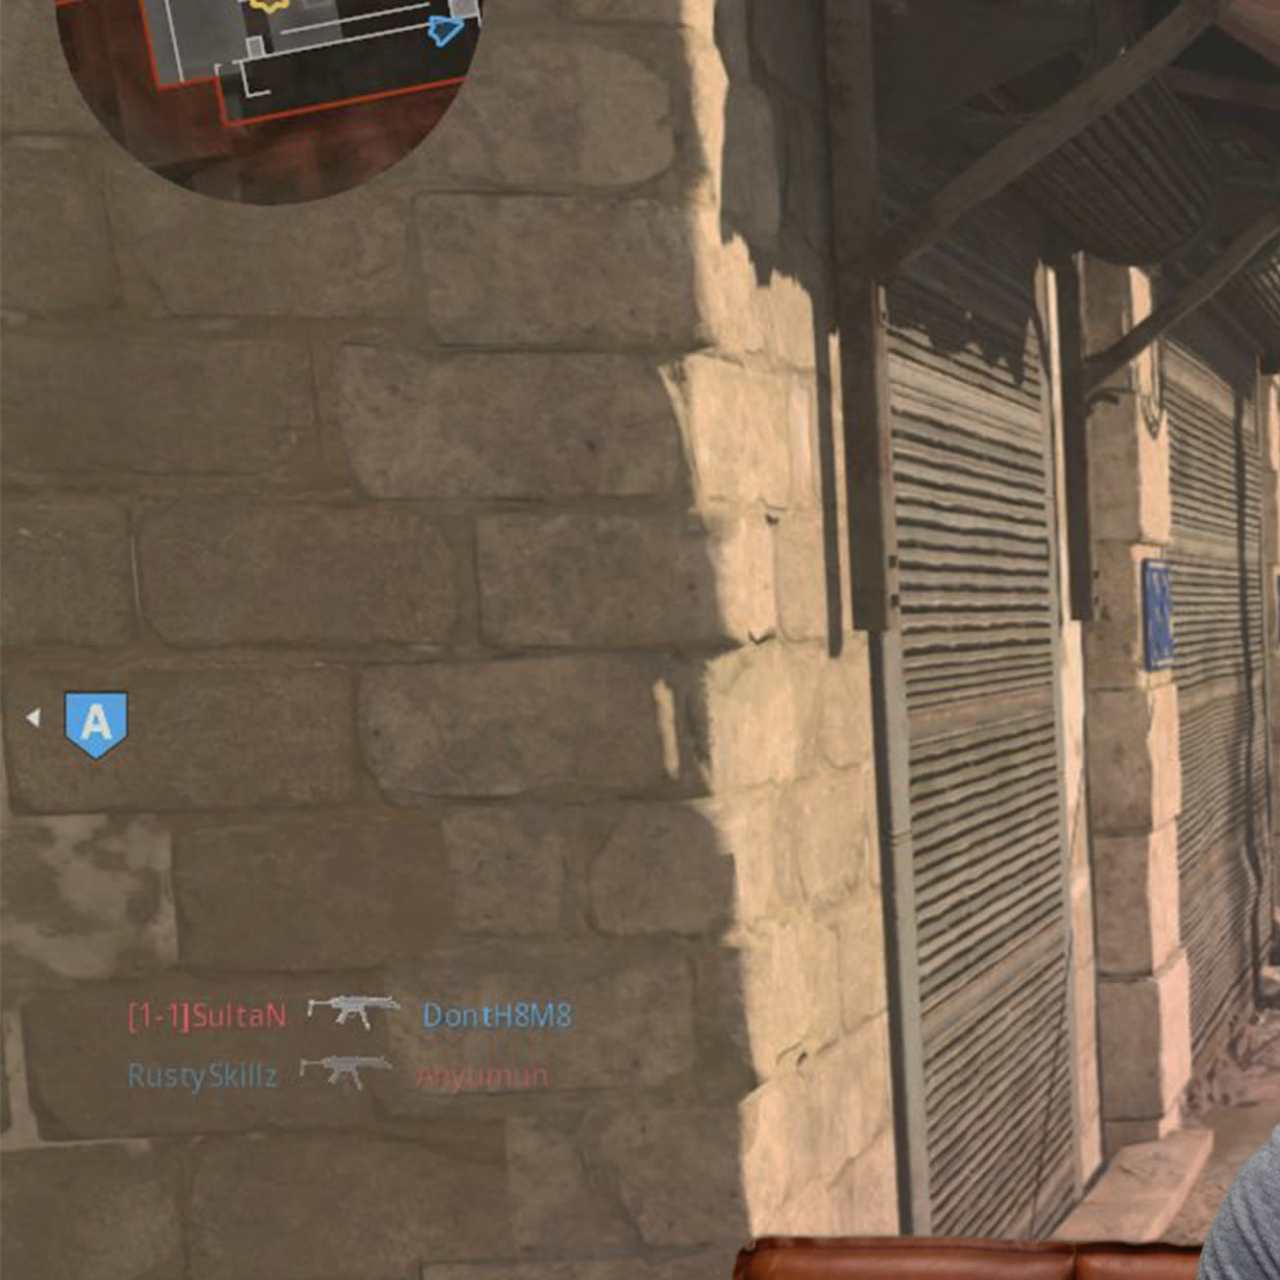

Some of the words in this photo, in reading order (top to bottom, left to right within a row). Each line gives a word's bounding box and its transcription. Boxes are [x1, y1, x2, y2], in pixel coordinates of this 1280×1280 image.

[80, 702, 113, 740] A
[422, 1002, 573, 1030] DontH8M8
[127, 1062, 279, 1094] RustySkillz
